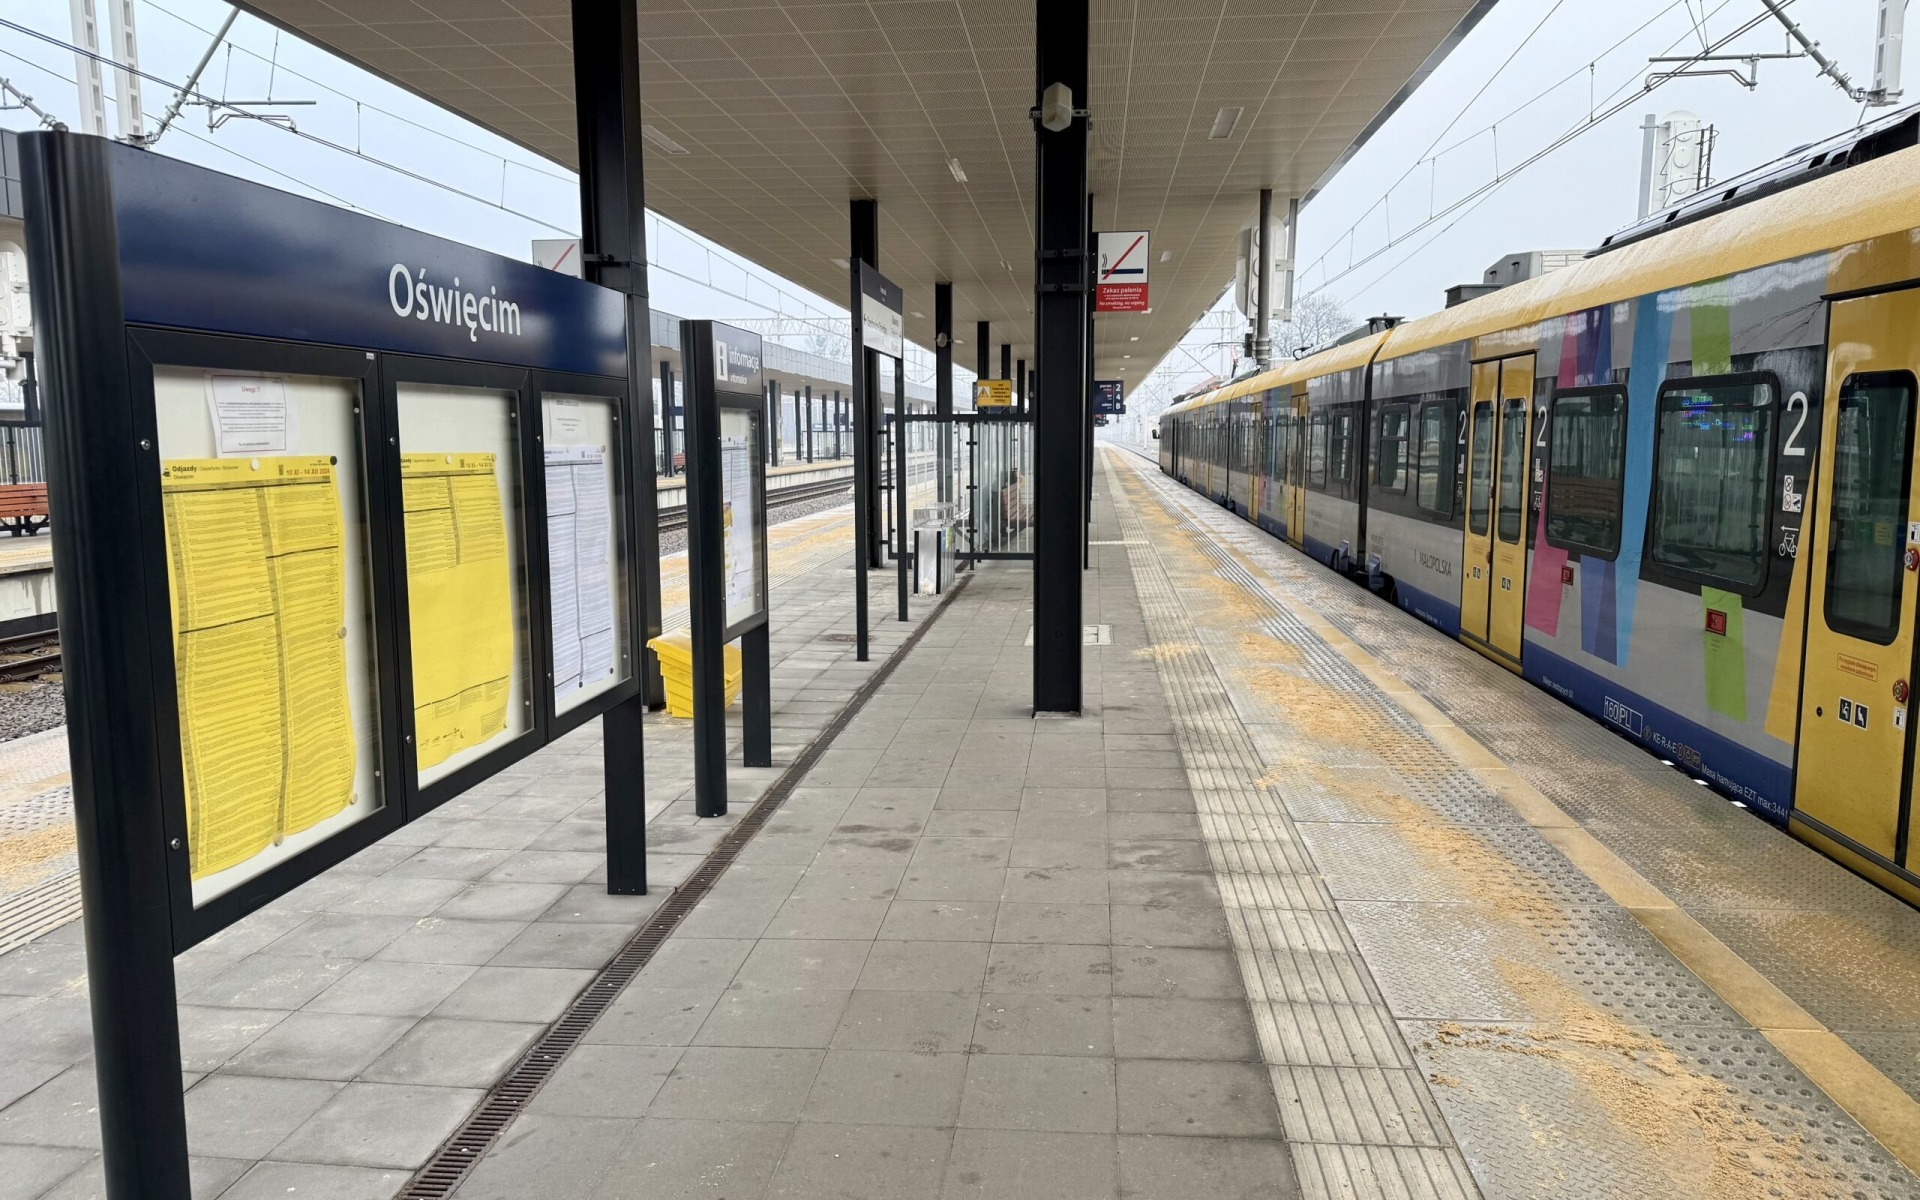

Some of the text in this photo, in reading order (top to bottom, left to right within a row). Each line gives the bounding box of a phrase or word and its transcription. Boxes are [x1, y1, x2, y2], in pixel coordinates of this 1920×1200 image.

[389, 263, 521, 342] Oświęcim
[1120, 286, 1142, 295] palenia
[728, 345, 759, 374] informacja
[1115, 383, 1121, 392] 2
[1458, 410, 1467, 445] 2
[1536, 405, 1547, 447] 2
[1783, 391, 1808, 456] 2
[172, 464, 198, 473] Odjazdy
[1604, 700, 1618, 720] 160
[1620, 707, 1631, 728] PL
[1701, 763, 1716, 780] Masa
[1744, 786, 1757, 802] EZT
